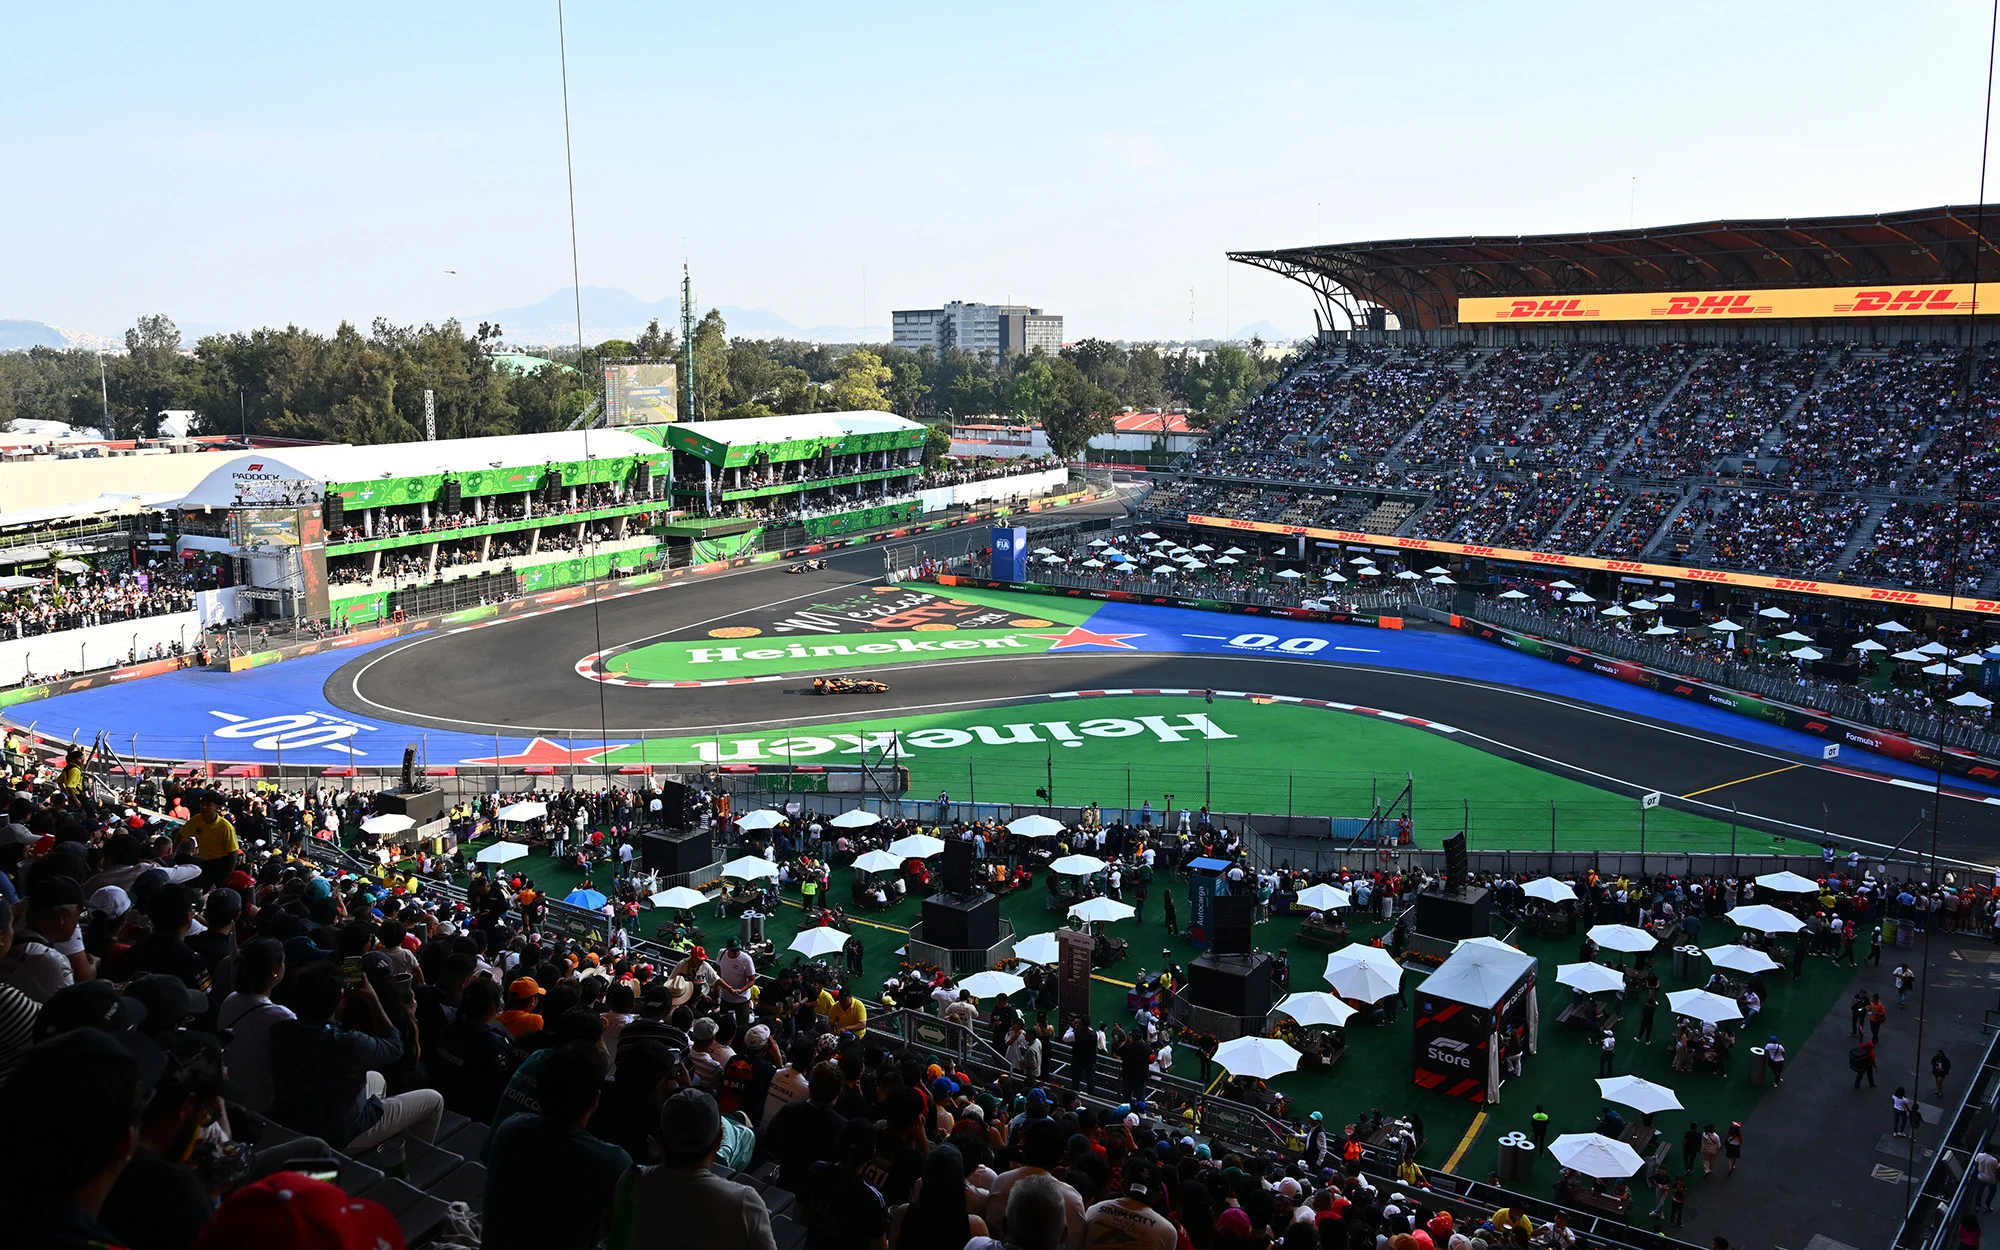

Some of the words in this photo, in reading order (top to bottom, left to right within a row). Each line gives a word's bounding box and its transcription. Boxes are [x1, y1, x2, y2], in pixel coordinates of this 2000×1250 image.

[1666, 295, 1756, 315] DHL
[1852, 289, 1959, 312] DHL
[1509, 299, 1585, 318] DHL
[1230, 520, 1255, 530] DHL
[1338, 531, 1367, 542] DHL
[997, 540, 1010, 549] FIA
[1398, 538, 1429, 549] DHL
[1462, 545, 1496, 556] DHL
[1531, 553, 1567, 564] DHL
[1606, 561, 1645, 573] DHL
[1687, 569, 1728, 582] DHL
[1774, 579, 1820, 592] DHL
[1870, 589, 1920, 603] DHL
[332, 638, 353, 646] Formula
[1228, 633, 1330, 652] 0.0
[1501, 636, 1516, 646] Formula
[685, 635, 1029, 664] Heineken
[1594, 662, 1614, 674] Formula
[109, 672, 136, 681] Formula
[1709, 694, 1732, 706] Formula
[697, 712, 1238, 763] Heineken
[1846, 732, 1873, 746] Formula
[1196, 886, 1206, 927] Autocarga
[1430, 1036, 1471, 1053] F1
[1428, 1047, 1471, 1069] Store
[1098, 1206, 1156, 1227] SIMPLICITY
